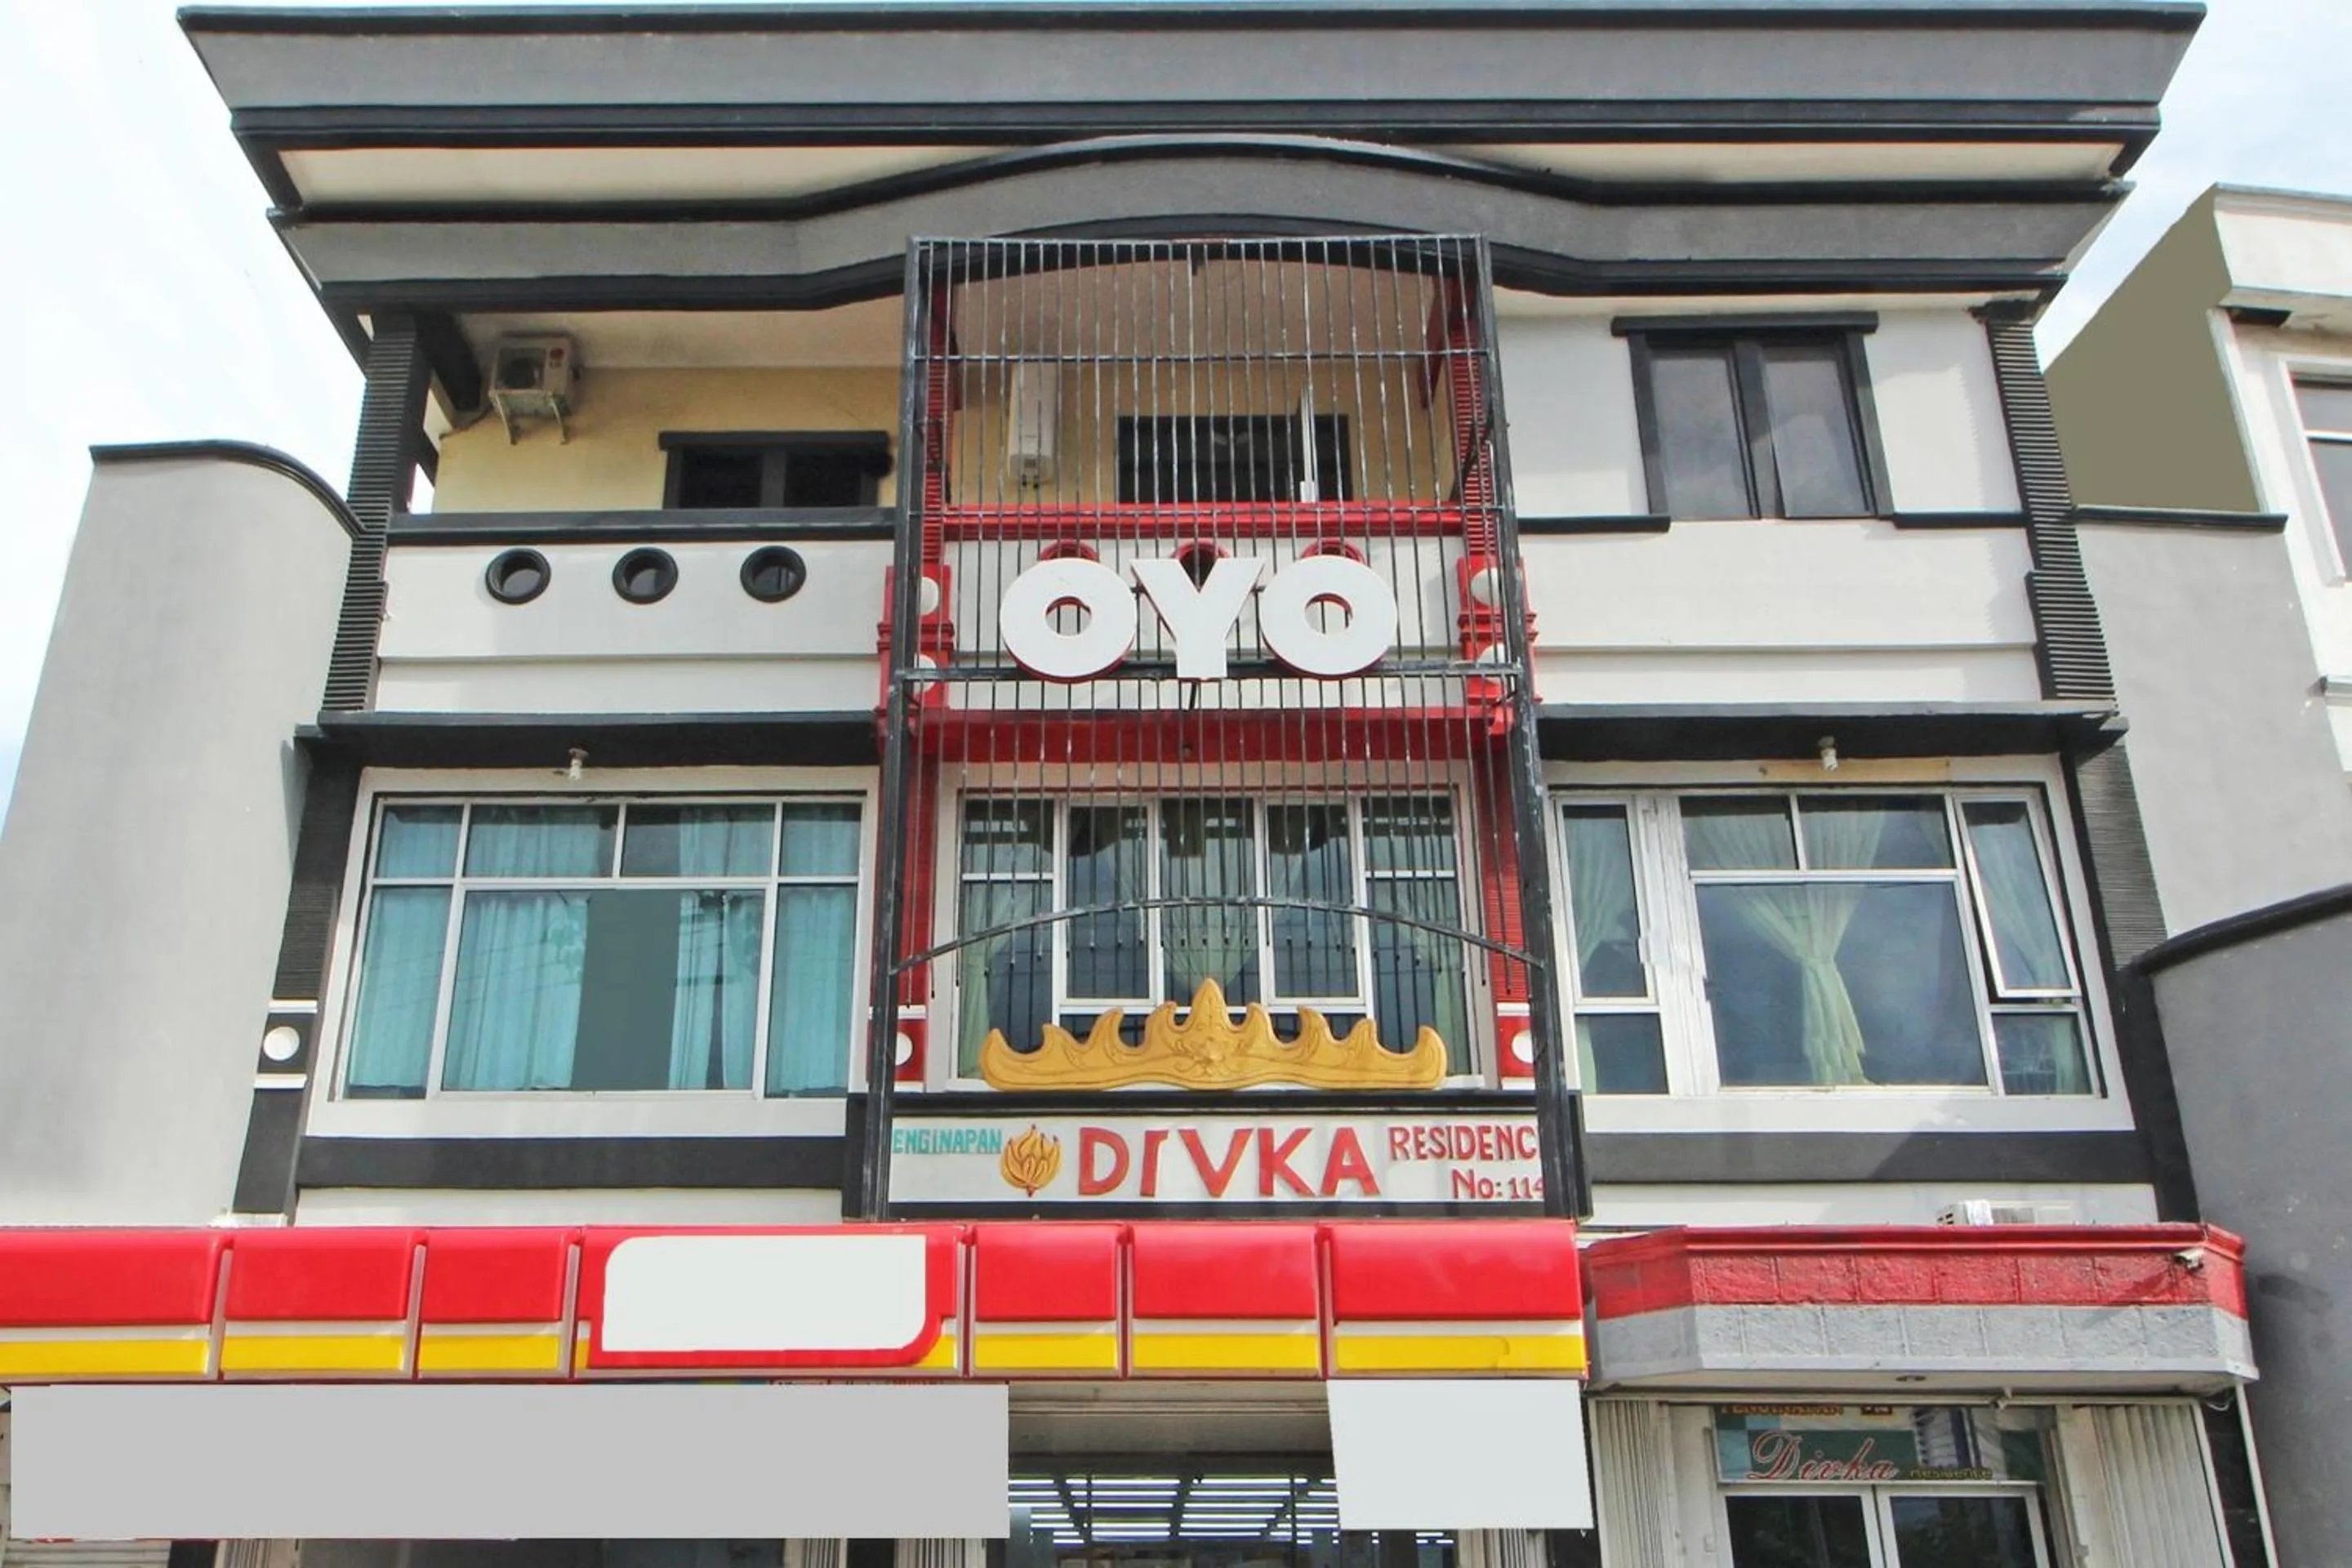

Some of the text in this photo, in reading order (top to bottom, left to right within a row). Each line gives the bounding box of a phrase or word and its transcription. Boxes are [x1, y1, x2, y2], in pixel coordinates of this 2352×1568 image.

[1000, 555, 1397, 684] OYO
[892, 1125, 1538, 1198] ENGINAPAN DIVKA RESIDENC
[1746, 1430, 1900, 1481] Divka
